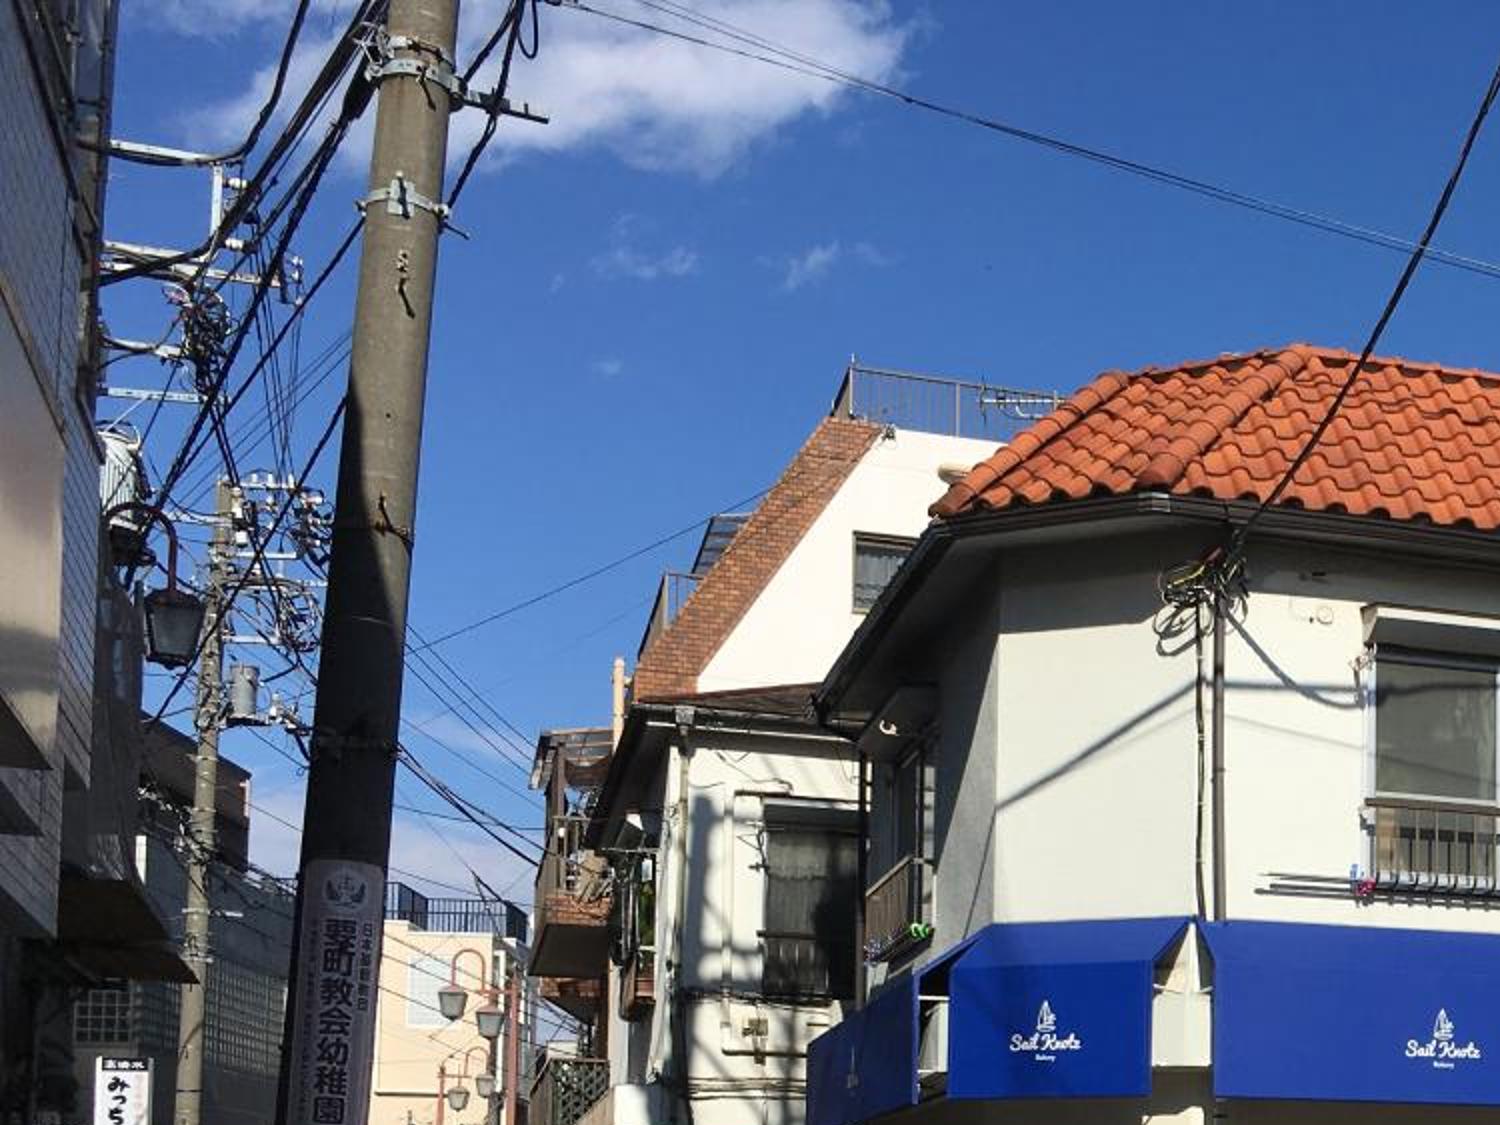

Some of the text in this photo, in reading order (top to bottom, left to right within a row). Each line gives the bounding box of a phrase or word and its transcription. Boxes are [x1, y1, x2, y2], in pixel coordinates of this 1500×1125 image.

[312, 918, 358, 1125] 要町教会幼稚園
[1009, 1032, 1082, 1052] Sail Knotz
[1404, 1039, 1482, 1059] Sail Knotz
